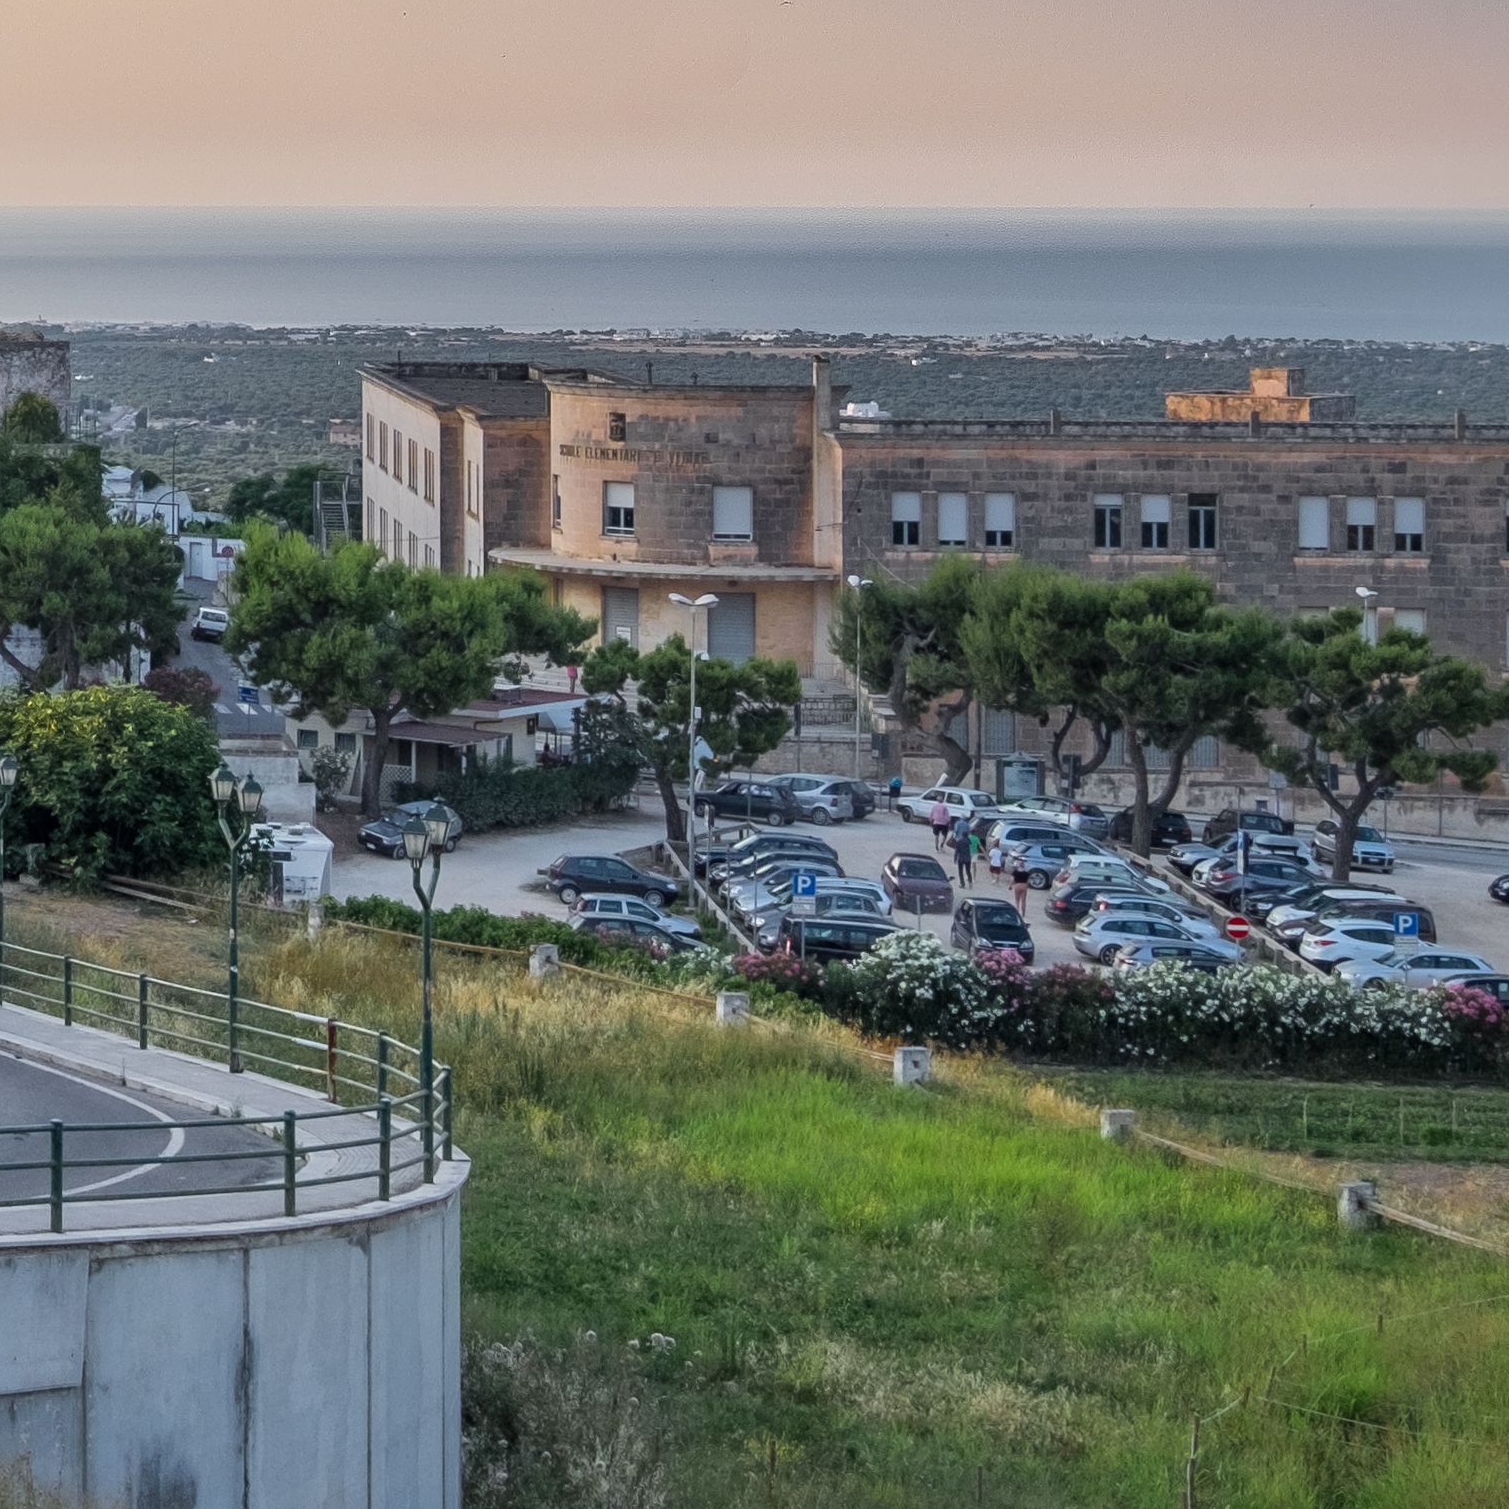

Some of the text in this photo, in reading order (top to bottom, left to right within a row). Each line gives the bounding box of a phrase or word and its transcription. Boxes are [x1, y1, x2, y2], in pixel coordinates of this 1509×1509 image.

[559, 444, 581, 459] SCLE
[797, 875, 812, 894] P
[1398, 914, 1413, 933] P
